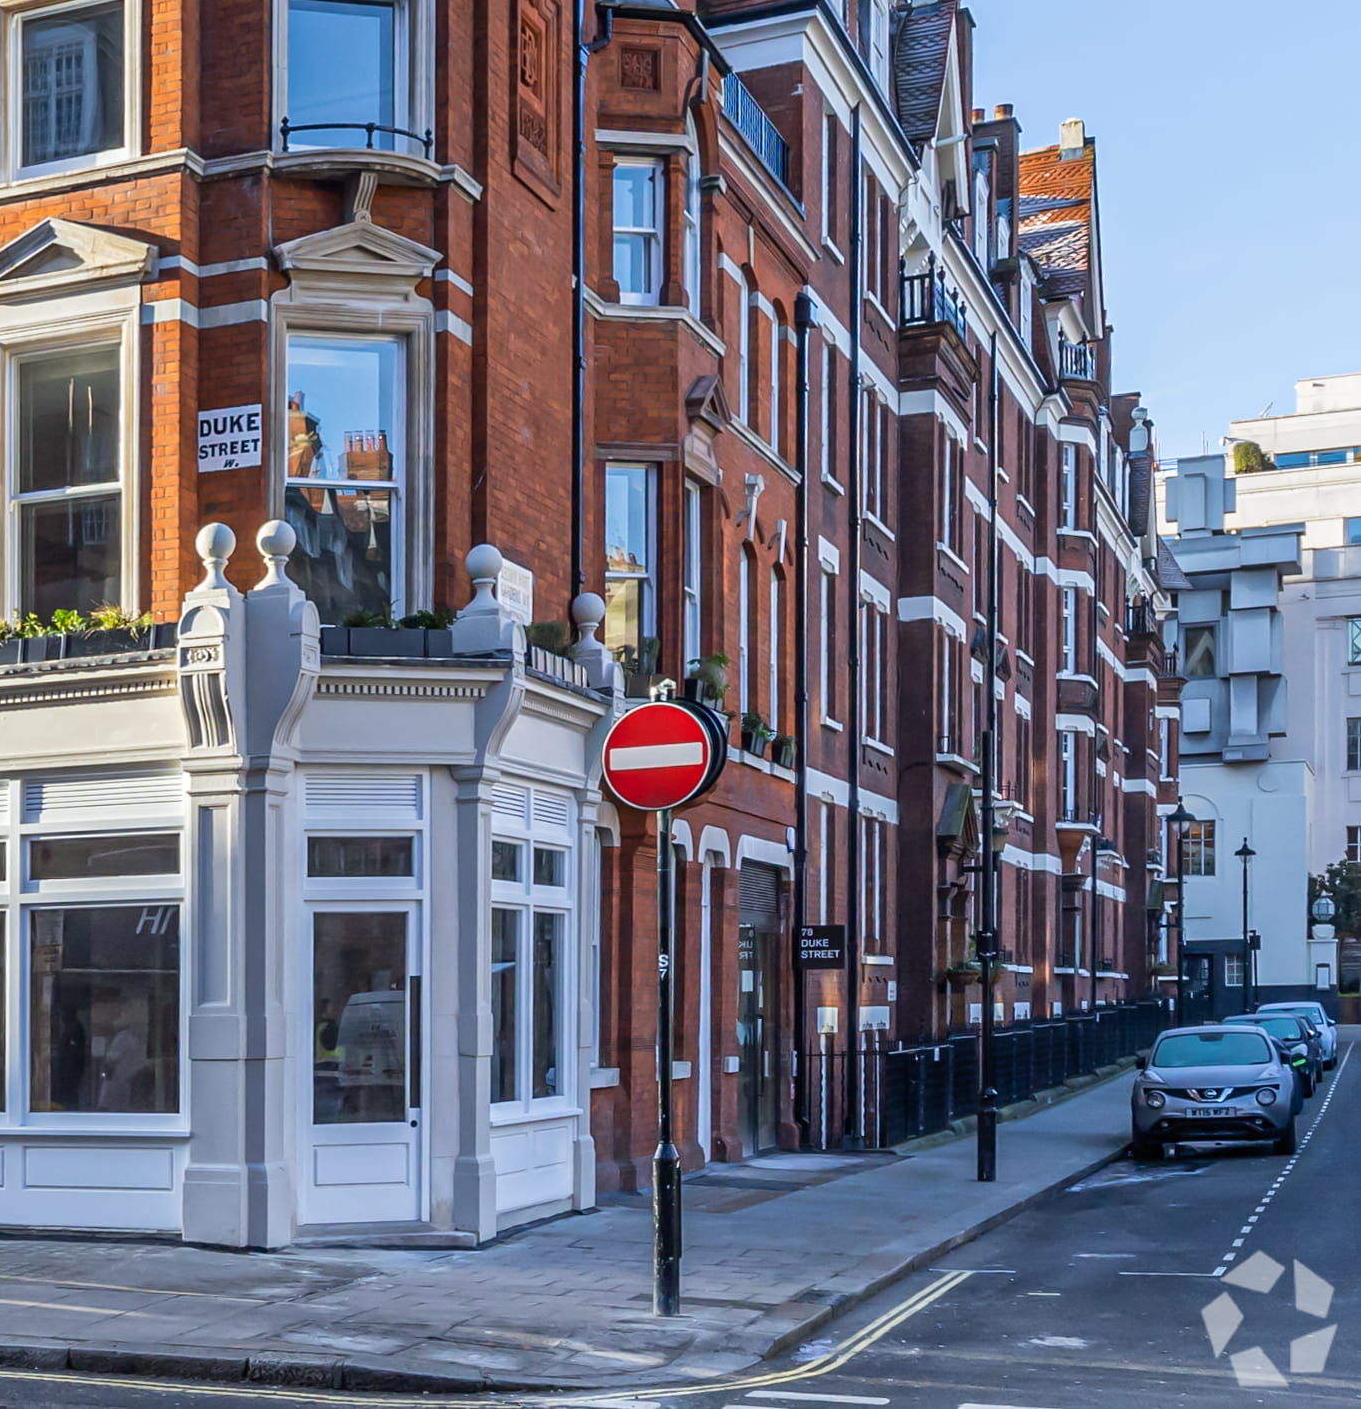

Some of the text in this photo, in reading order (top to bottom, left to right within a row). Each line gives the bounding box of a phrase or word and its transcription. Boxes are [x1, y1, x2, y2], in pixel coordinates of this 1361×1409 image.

[199, 412, 260, 438] DUKE
[199, 438, 260, 460] STREET
[800, 928, 814, 937] 78
[800, 939, 829, 948] DUKE
[800, 949, 840, 959] STREET
